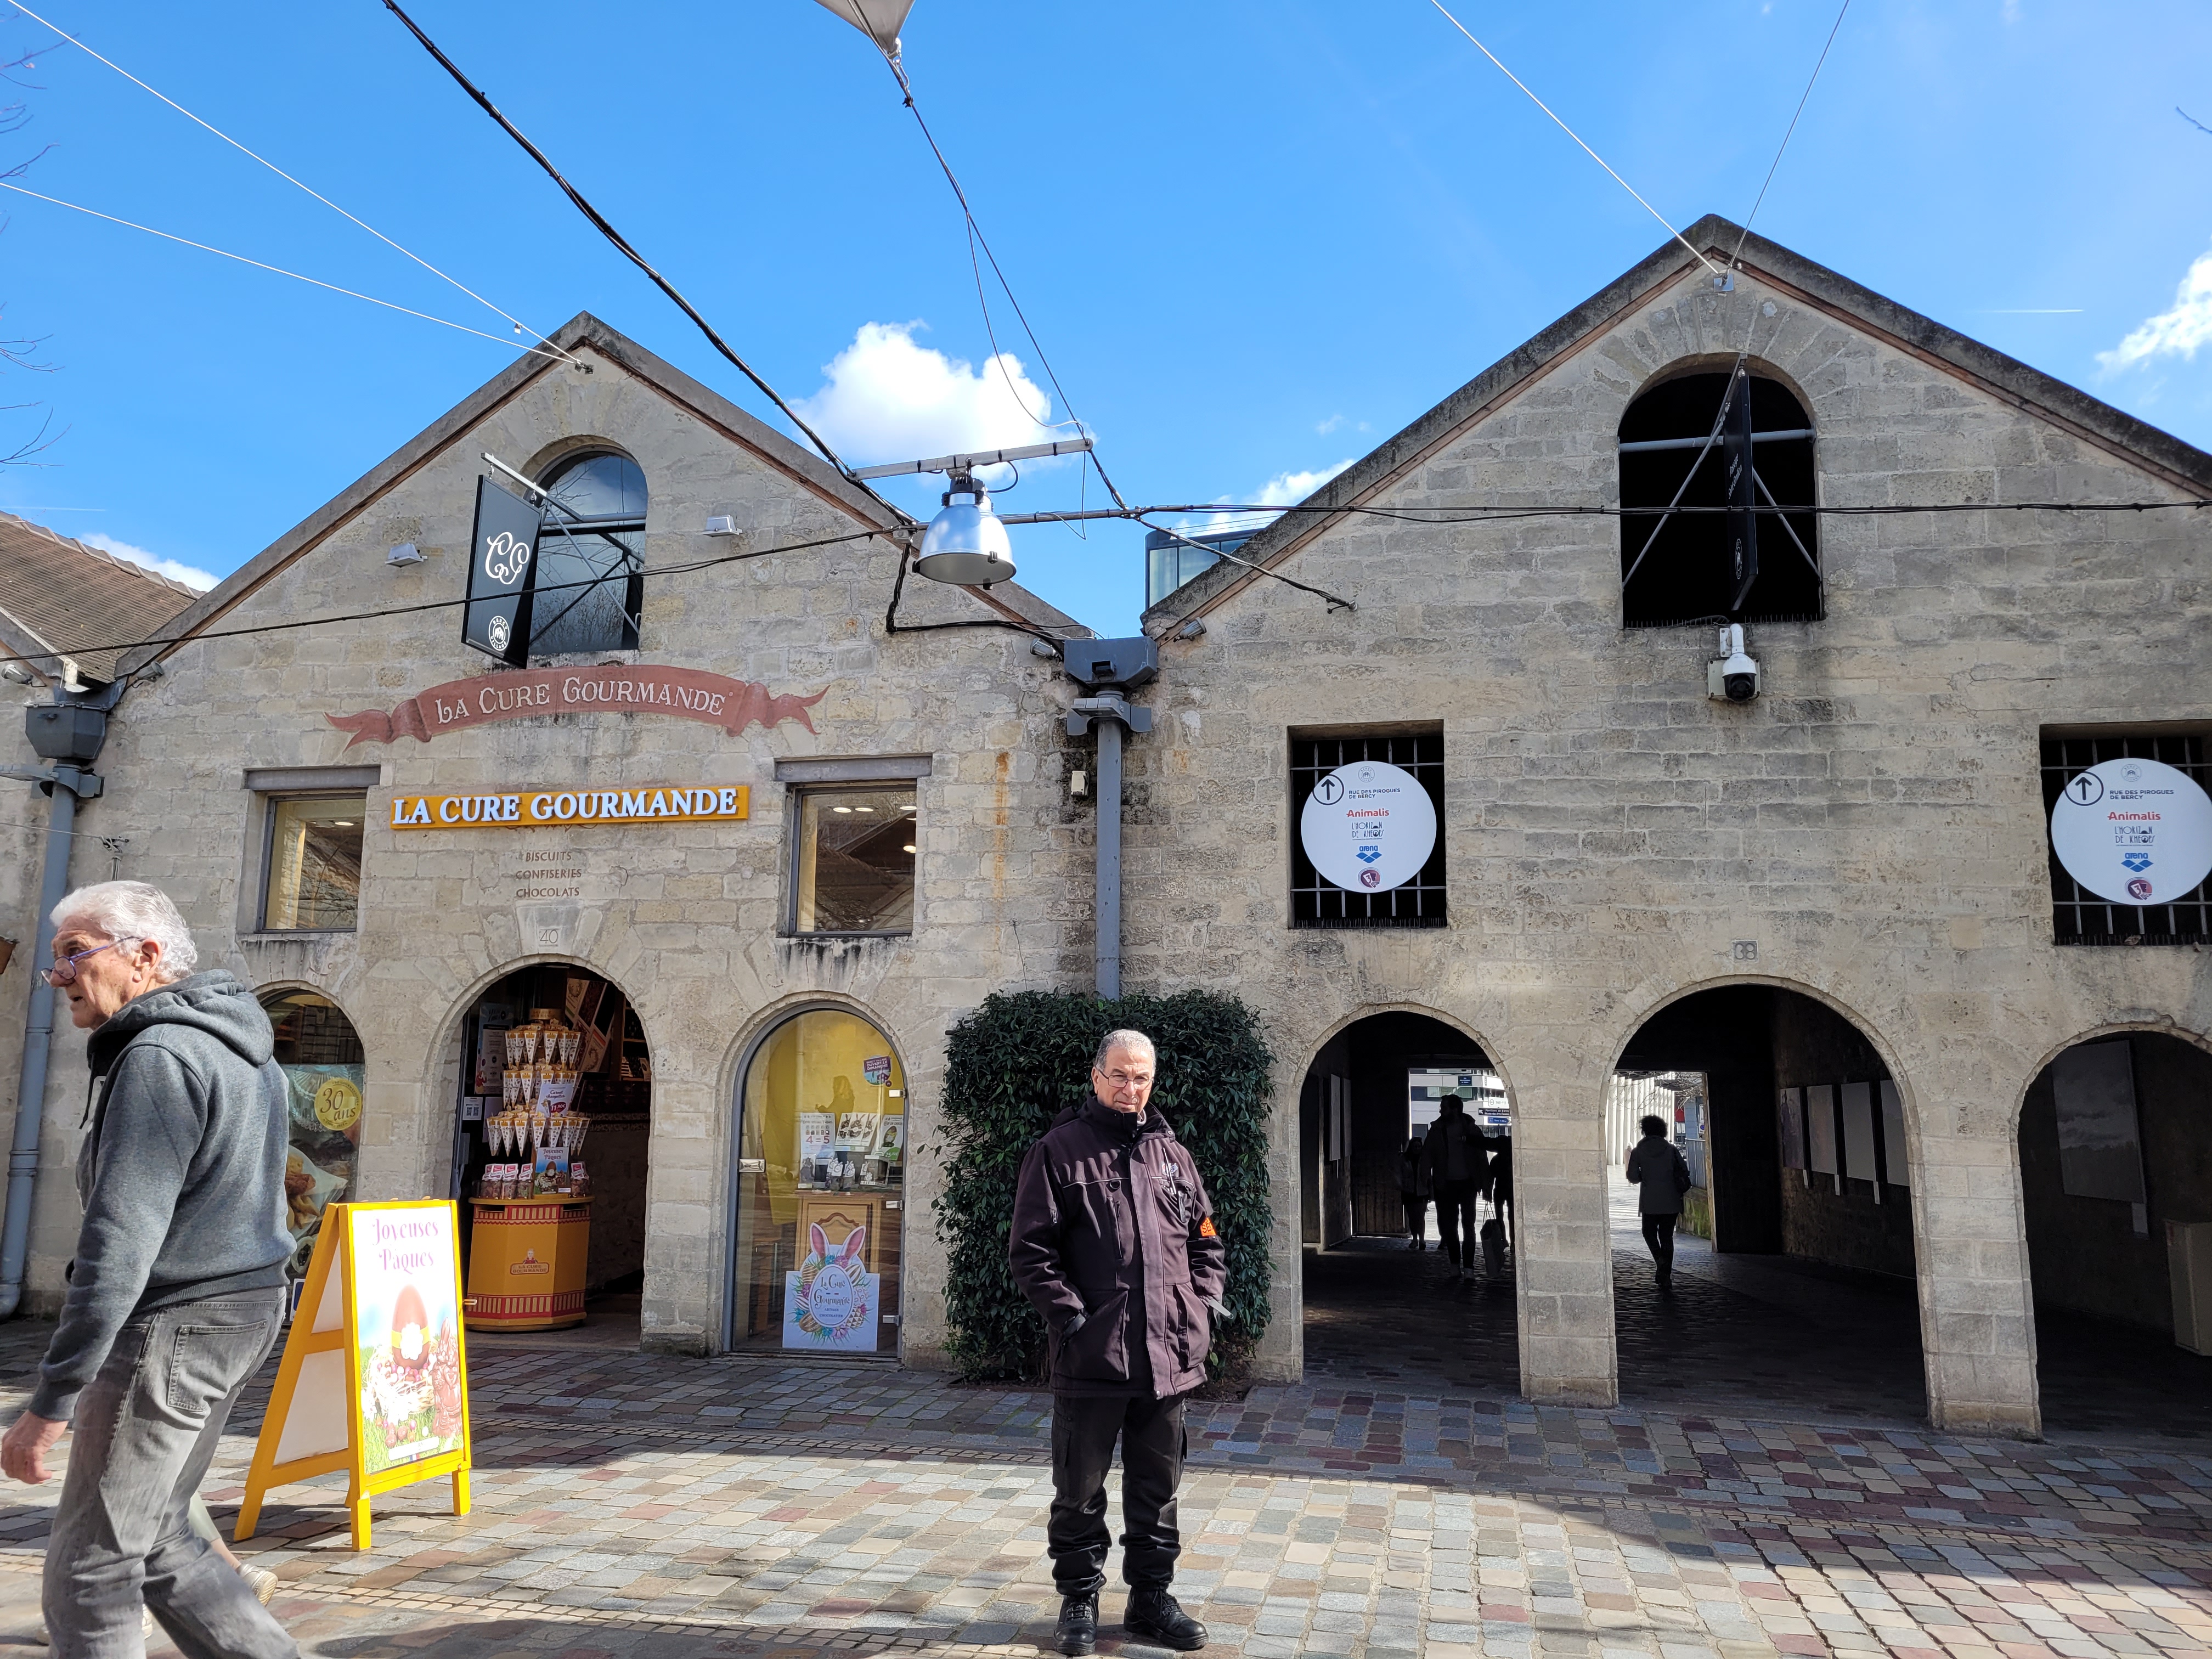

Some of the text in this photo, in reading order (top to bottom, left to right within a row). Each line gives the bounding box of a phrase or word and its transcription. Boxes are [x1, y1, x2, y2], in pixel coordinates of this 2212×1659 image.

[493, 618, 507, 629] BERCY
[490, 636, 506, 648] VILLAGE
[478, 684, 550, 713] CURE
[392, 788, 737, 824] LA CURE GOURMANDE
[1346, 808, 1389, 817] Animalis
[2107, 811, 2161, 820] Animalis
[526, 852, 572, 861] BISCUITS
[516, 869, 582, 879] CONFISERIES
[516, 888, 579, 897] CHOCOLATS
[539, 929, 558, 944] 40
[1735, 943, 1755, 960] 38
[320, 1088, 343, 1113] 30
[334, 1108, 356, 1121] ans
[806, 1136, 813, 1144] 4
[823, 1136, 830, 1144] 5
[373, 1218, 438, 1245] Joyeuses
[821, 1274, 845, 1290] La Cure
[814, 1289, 850, 1308] Gourmande
